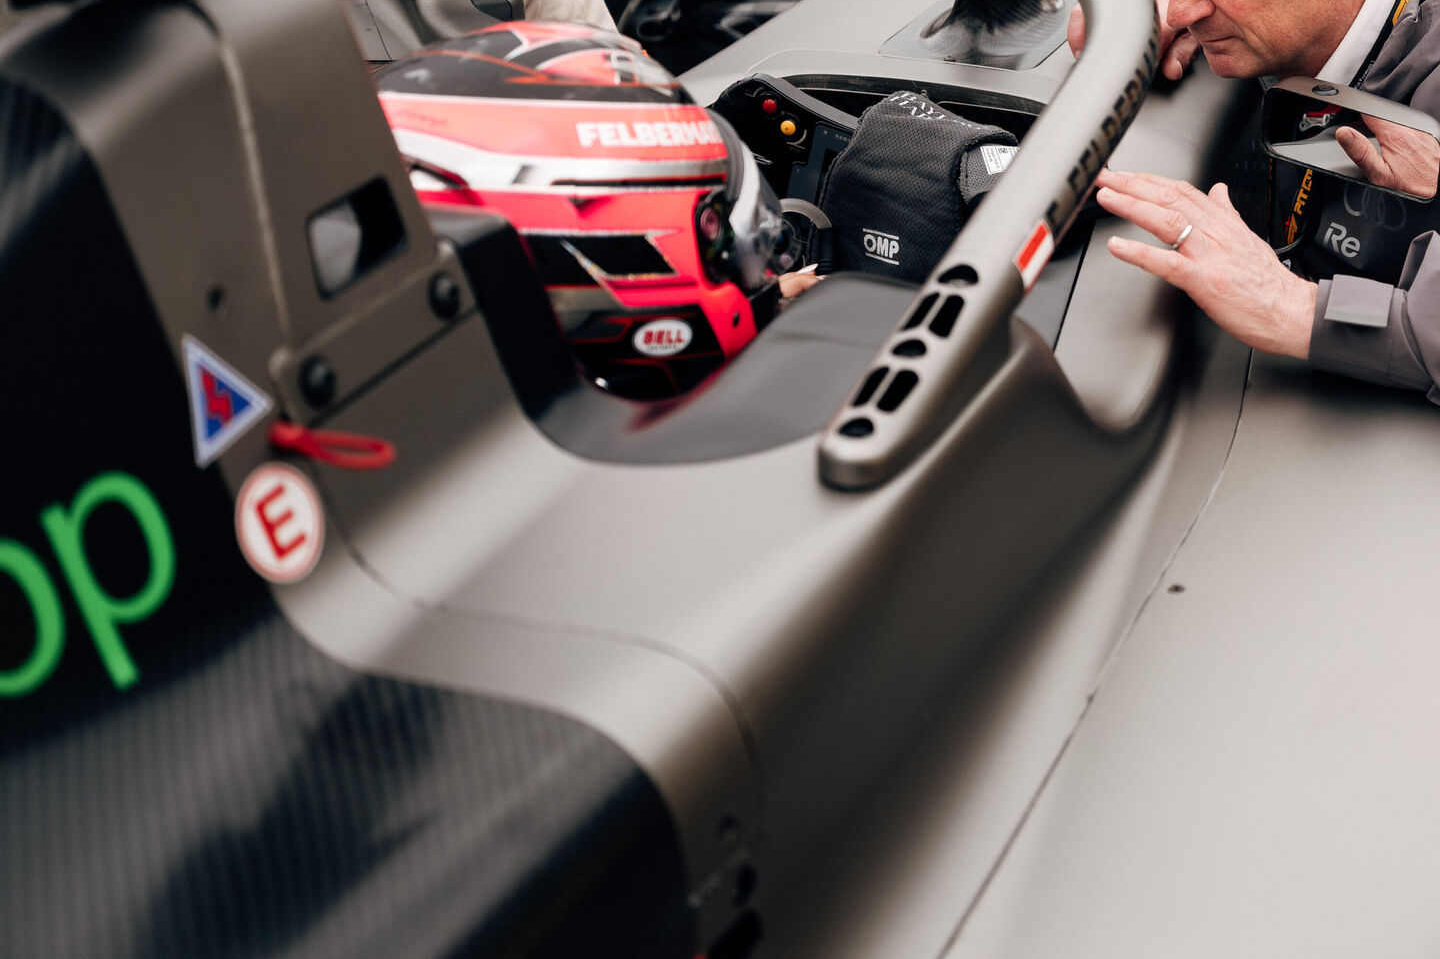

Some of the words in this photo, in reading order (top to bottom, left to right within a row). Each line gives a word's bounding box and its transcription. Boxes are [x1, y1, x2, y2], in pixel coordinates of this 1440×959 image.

[863, 234, 900, 259] OMP
[1322, 221, 1361, 258] Re
[643, 329, 685, 346] BELL
[255, 484, 307, 560] E
